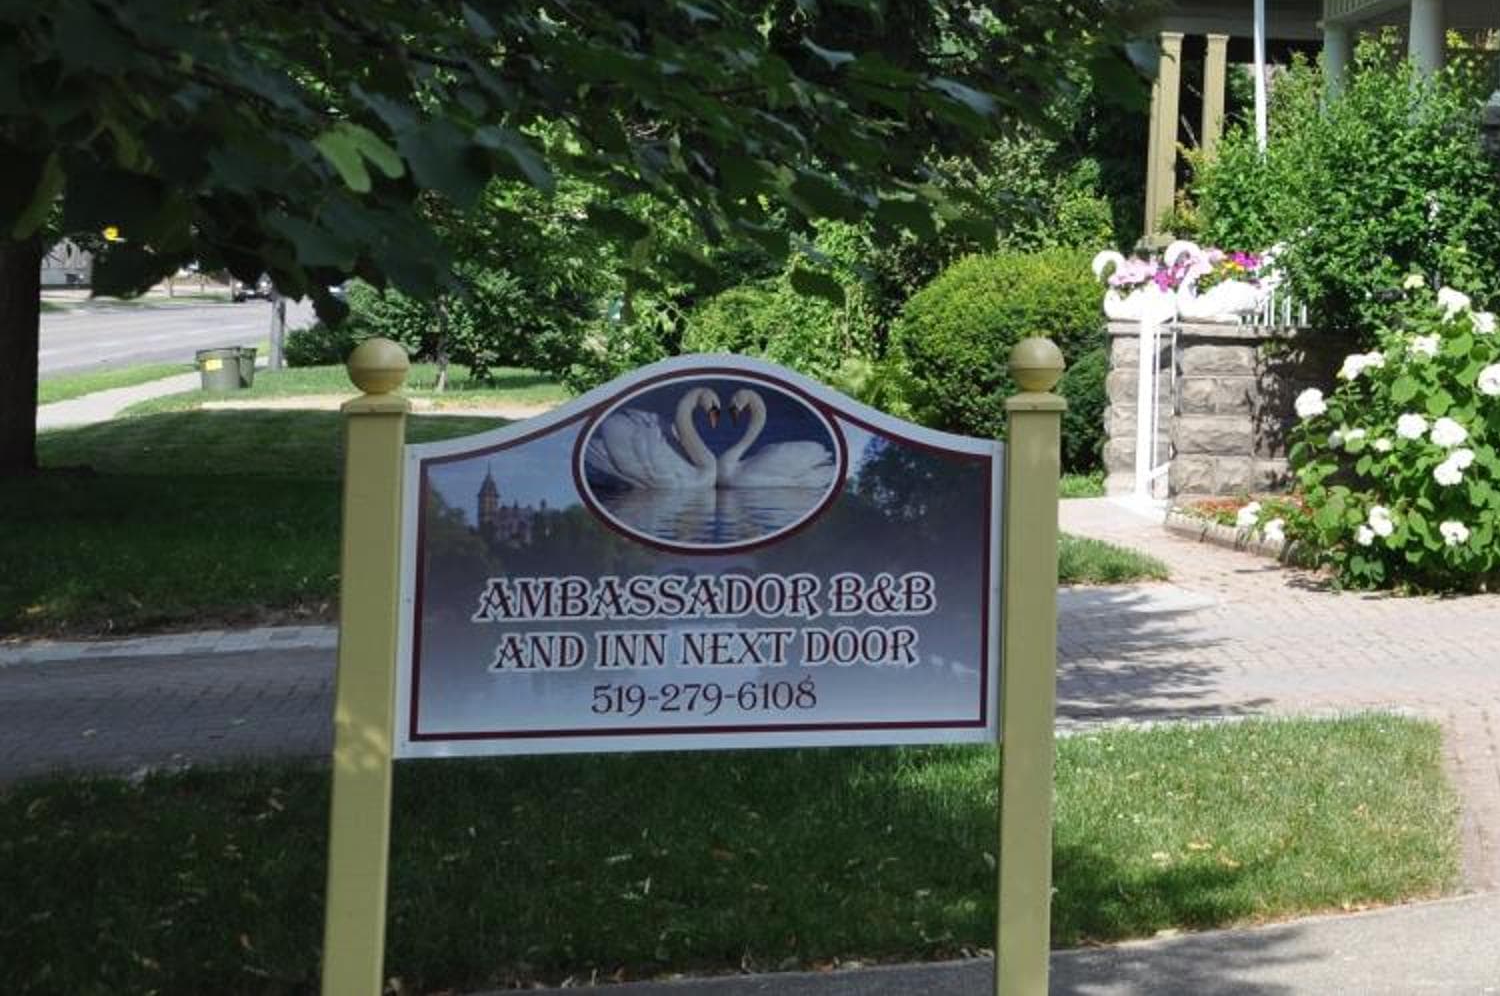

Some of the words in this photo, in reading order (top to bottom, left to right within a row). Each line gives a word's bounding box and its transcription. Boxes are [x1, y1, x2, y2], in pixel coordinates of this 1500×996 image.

[475, 574, 820, 620] AMBASSADOR
[830, 574, 935, 615] B&B
[494, 633, 586, 669] AND
[599, 632, 669, 667] INN
[681, 630, 794, 665] NEXT
[805, 627, 918, 665] DOOR
[591, 677, 818, 717] 519-279-6108
